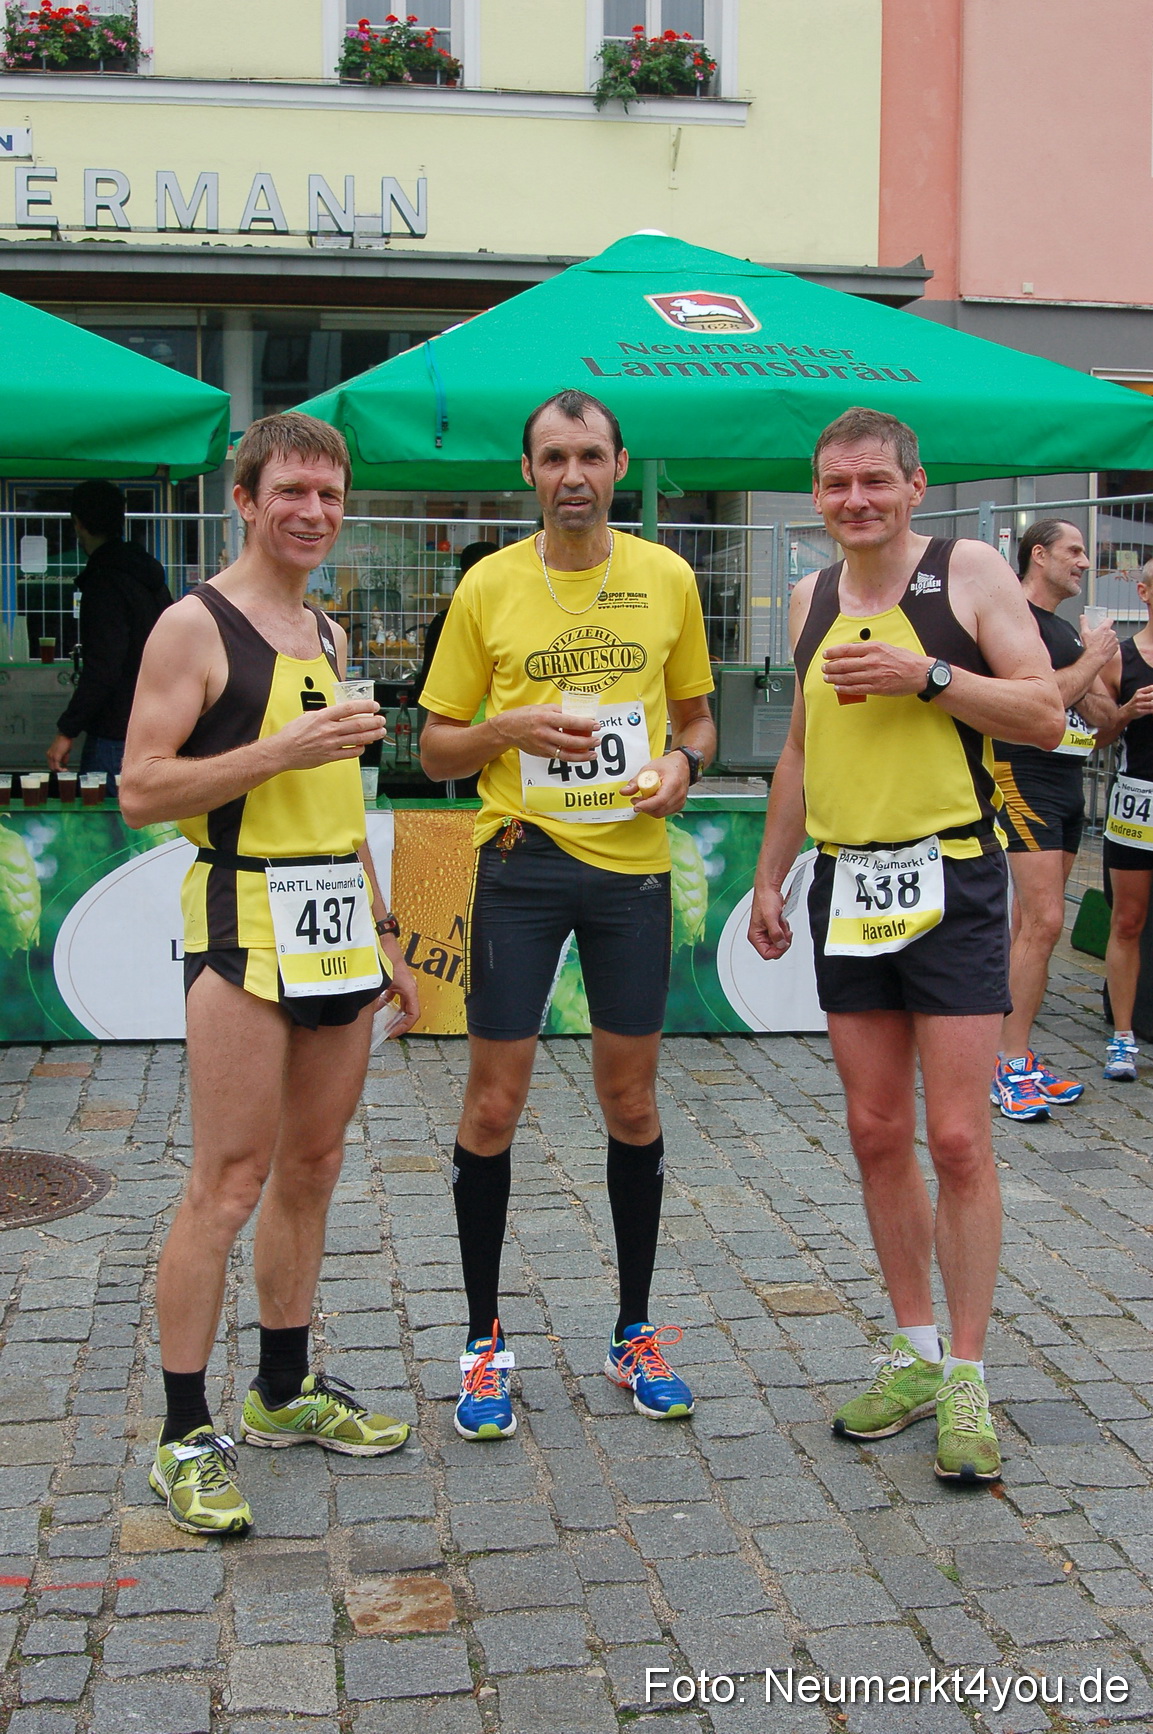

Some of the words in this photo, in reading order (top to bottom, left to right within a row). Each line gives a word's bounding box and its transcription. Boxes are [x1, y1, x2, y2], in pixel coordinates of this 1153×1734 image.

[15, 167, 427, 238] ERMANN
[616, 341, 855, 360] Neumarkter
[581, 356, 922, 383] Lammsbräu
[552, 628, 618, 652] PIZZERIA
[541, 647, 632, 676] FRANCESCO
[557, 673, 619, 693] HERSBRUCK
[565, 791, 615, 807] Dieter
[1114, 792, 1151, 822] 194
[1111, 821, 1142, 838] Andreas
[838, 853, 870, 868] PARTL
[872, 857, 925, 871] Neumarkt
[270, 880, 313, 892] PARTL
[316, 877, 356, 890] Neumarkt
[855, 870, 921, 910] 438
[295, 896, 356, 945] 437
[862, 919, 906, 940] Harald
[321, 956, 347, 977] Ulli
